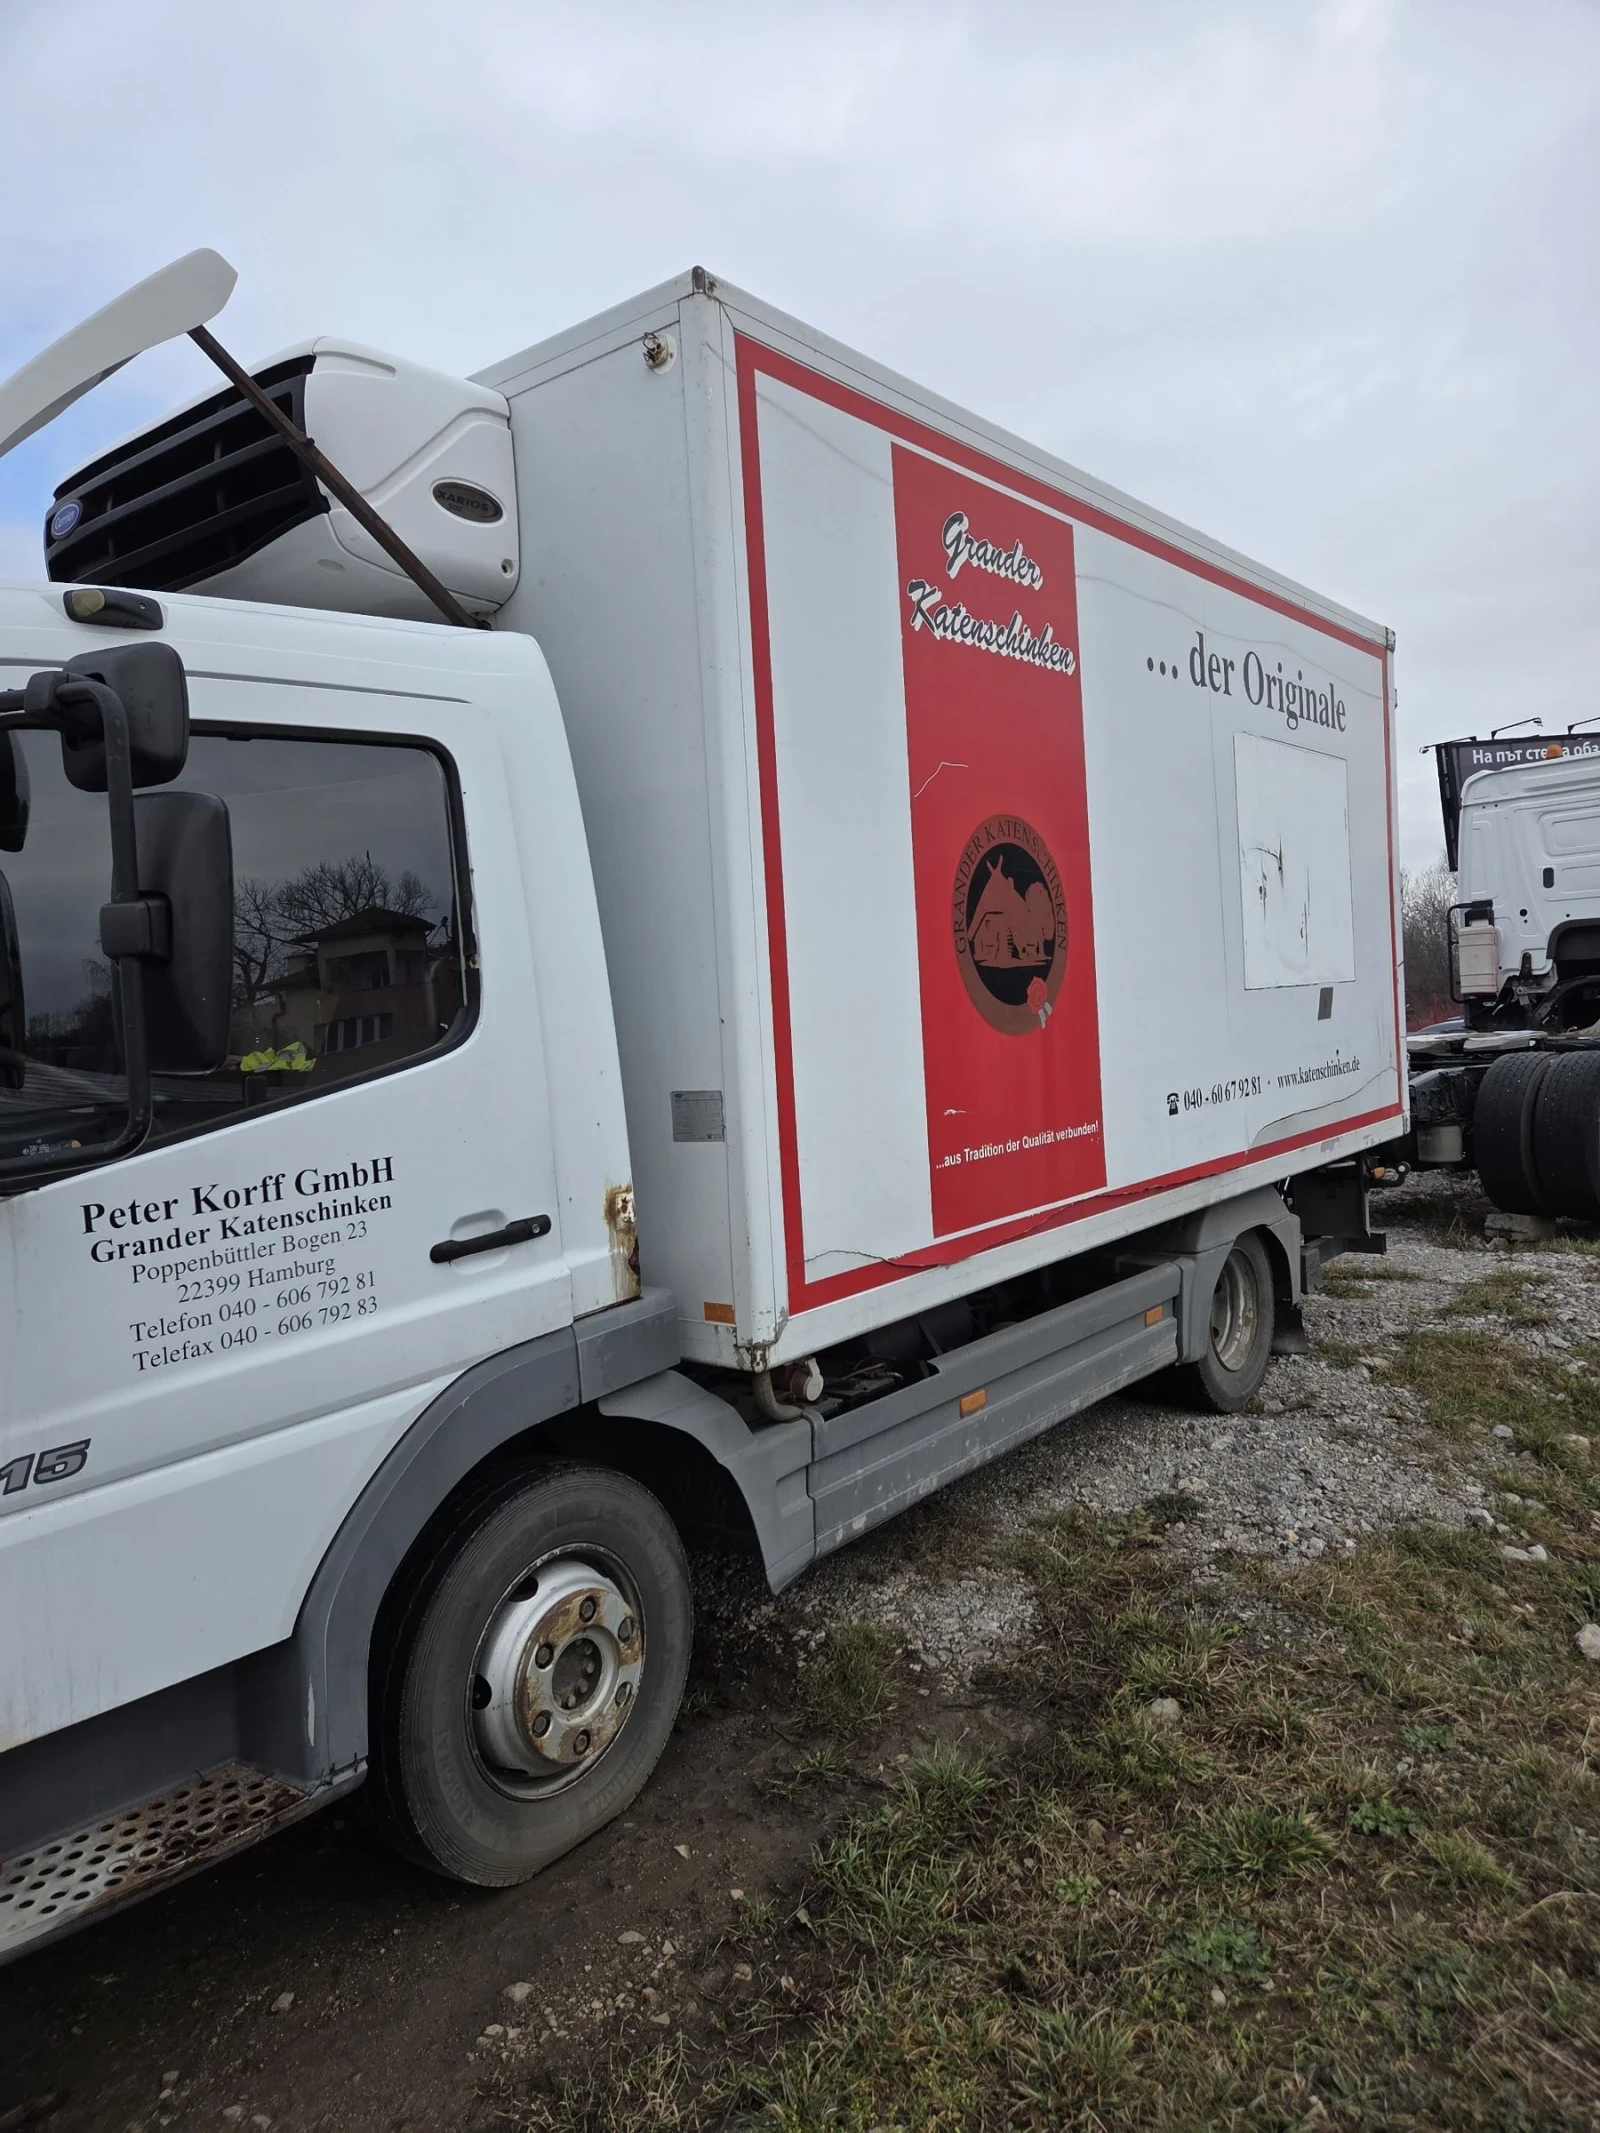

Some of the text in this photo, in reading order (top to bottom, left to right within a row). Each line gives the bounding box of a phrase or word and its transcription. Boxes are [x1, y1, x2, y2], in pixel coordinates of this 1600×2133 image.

[438, 490, 489, 511] XARIOS
[942, 511, 1043, 590] Grander
[907, 579, 1076, 675] Katenschinken
[1189, 631, 1234, 696] der
[1243, 651, 1346, 732] Originale
[1472, 749, 1493, 764] На
[1496, 749, 1522, 762] път
[953, 819, 1068, 954] GRANDER KATENSCHINKEN
[1184, 1088, 1202, 1111] 040
[1277, 1055, 1360, 1089] www.katenschinken.de
[936, 1120, 1099, 1169] ...aus Tradition der Qualität verbunden!
[79, 1156, 395, 1235] Peter Korff GmbH
[90, 1194, 393, 1264] Grander Katenschinken
[131, 1220, 367, 1284] Poppenbüttler Bogen 23
[177, 1258, 336, 1304] 22399 Hamburg
[130, 1312, 212, 1343] Telefon
[219, 1298, 256, 1322] 040
[276, 1284, 311, 1309] 606
[317, 1276, 351, 1299] 792
[356, 1269, 376, 1290] 81
[132, 1340, 214, 1372] Telefax
[220, 1325, 258, 1350] 040
[278, 1310, 313, 1337] 606
[318, 1301, 352, 1326] 792
[357, 1295, 378, 1317] 83
